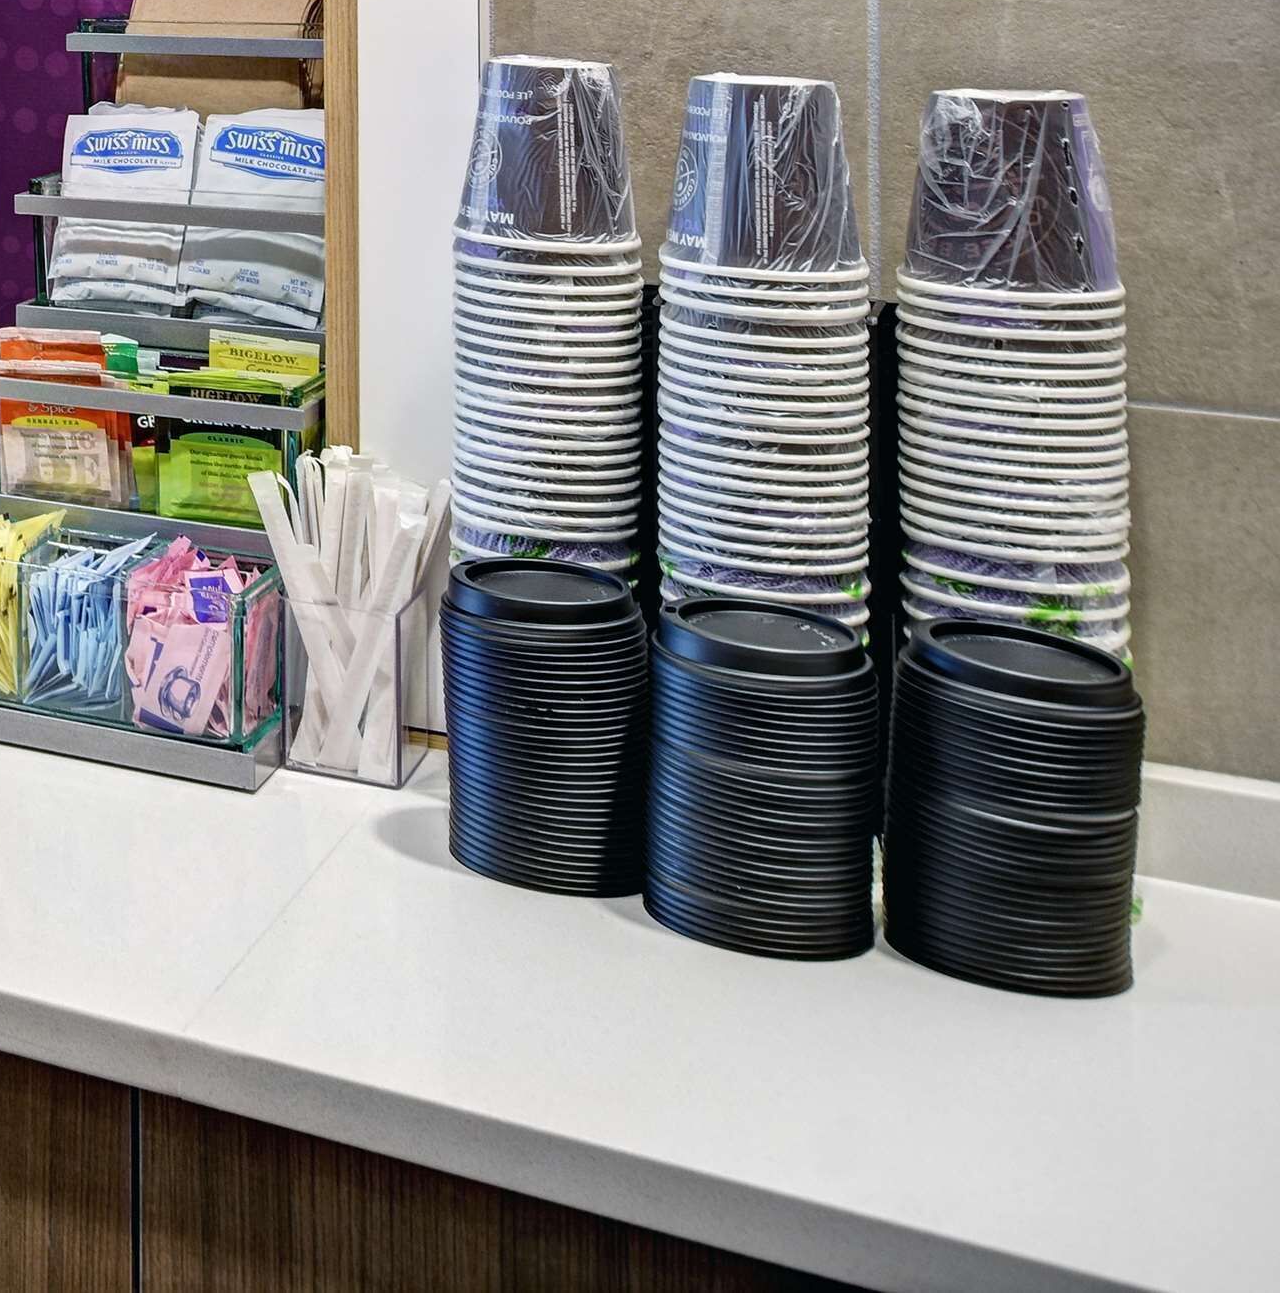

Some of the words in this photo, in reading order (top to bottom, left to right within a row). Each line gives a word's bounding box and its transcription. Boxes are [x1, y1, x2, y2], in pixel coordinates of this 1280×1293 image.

[234, 156, 255, 166] MILK
[256, 160, 307, 175] CHOCOLATE
[27, 418, 59, 426] HERBAL
[207, 435, 245, 444] CLASSIC
